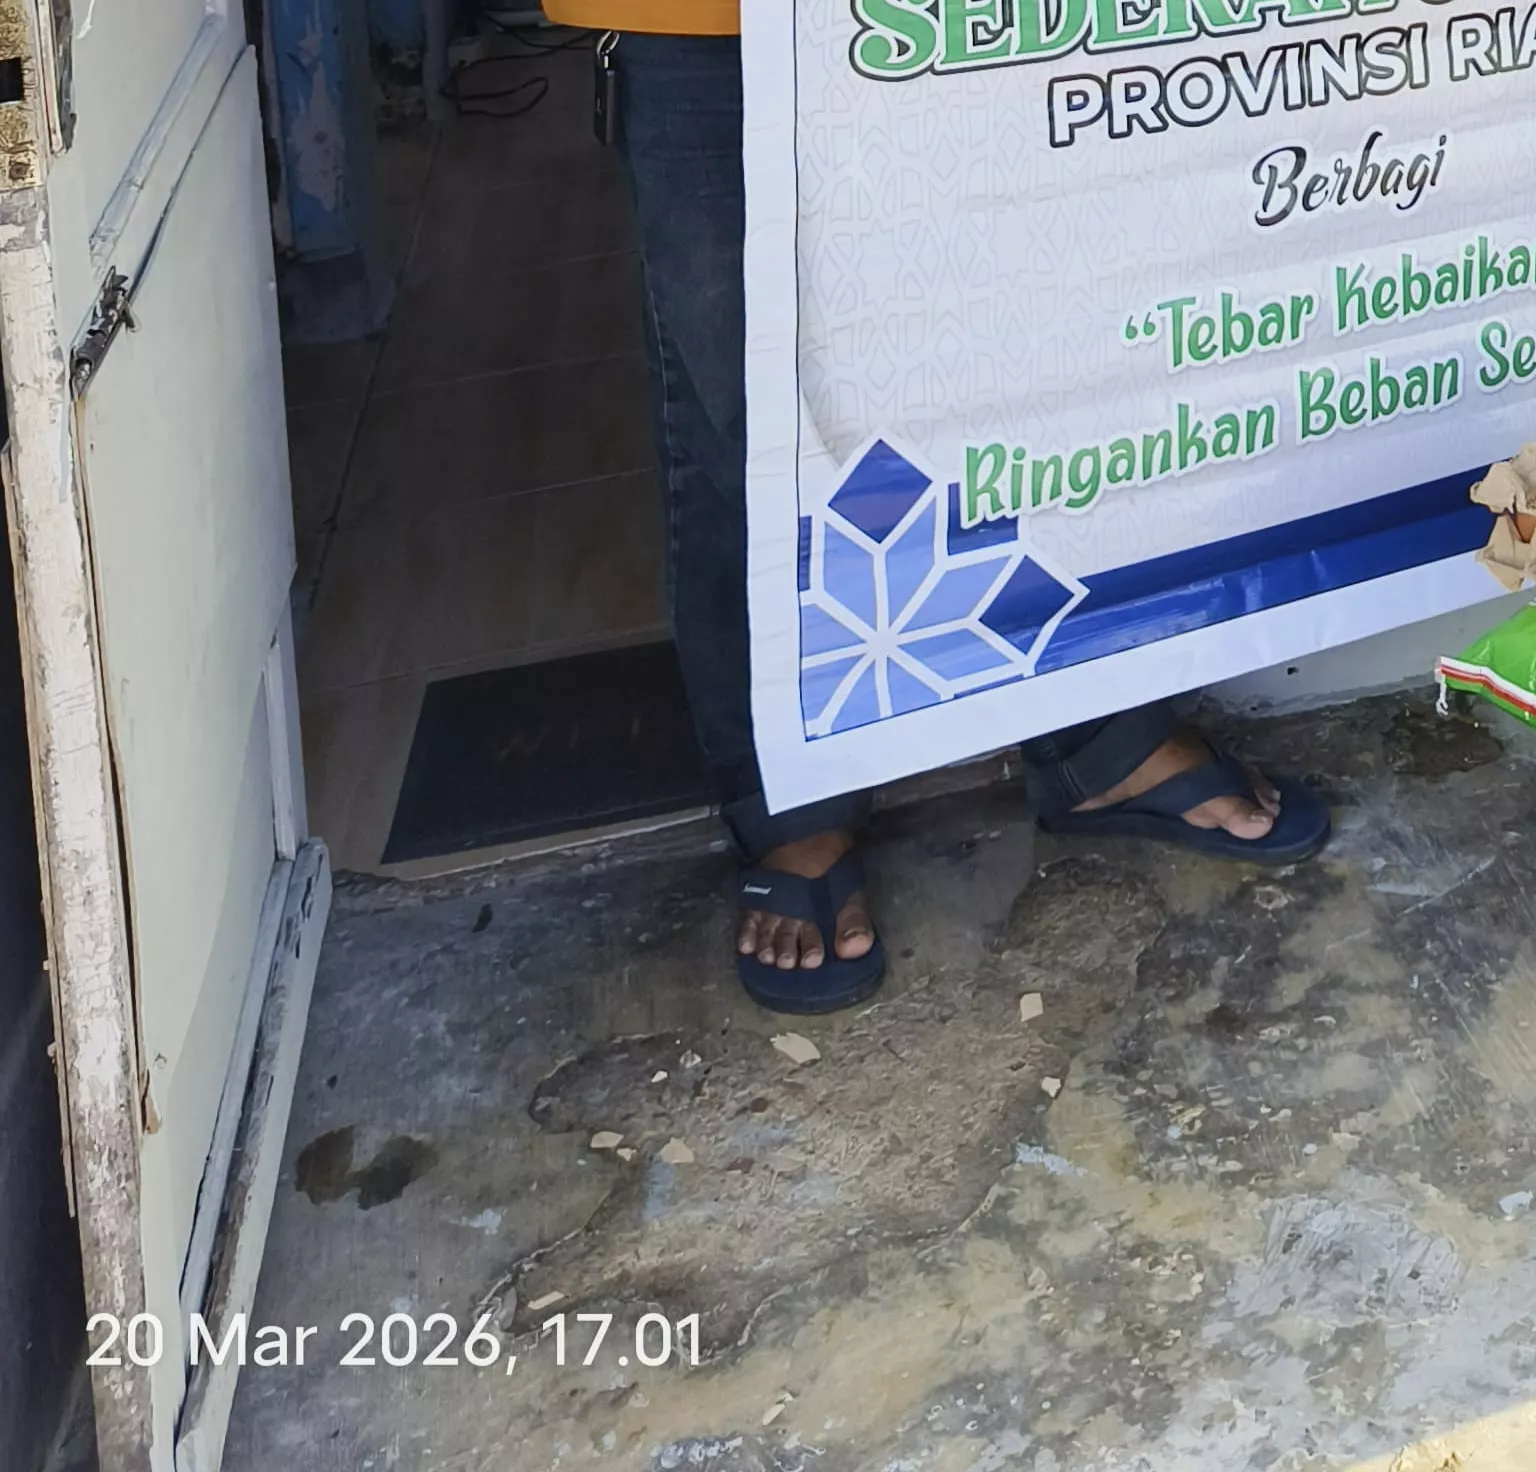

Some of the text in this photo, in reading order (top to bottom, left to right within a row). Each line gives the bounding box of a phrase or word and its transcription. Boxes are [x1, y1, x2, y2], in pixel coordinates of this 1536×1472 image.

[1047, 27, 1429, 146] PROVINSI
[1252, 131, 1447, 226] Berbagi
[1124, 291, 1313, 369] “Tebar
[964, 402, 1276, 523] Ringankan
[1298, 354, 1460, 436] Beban
